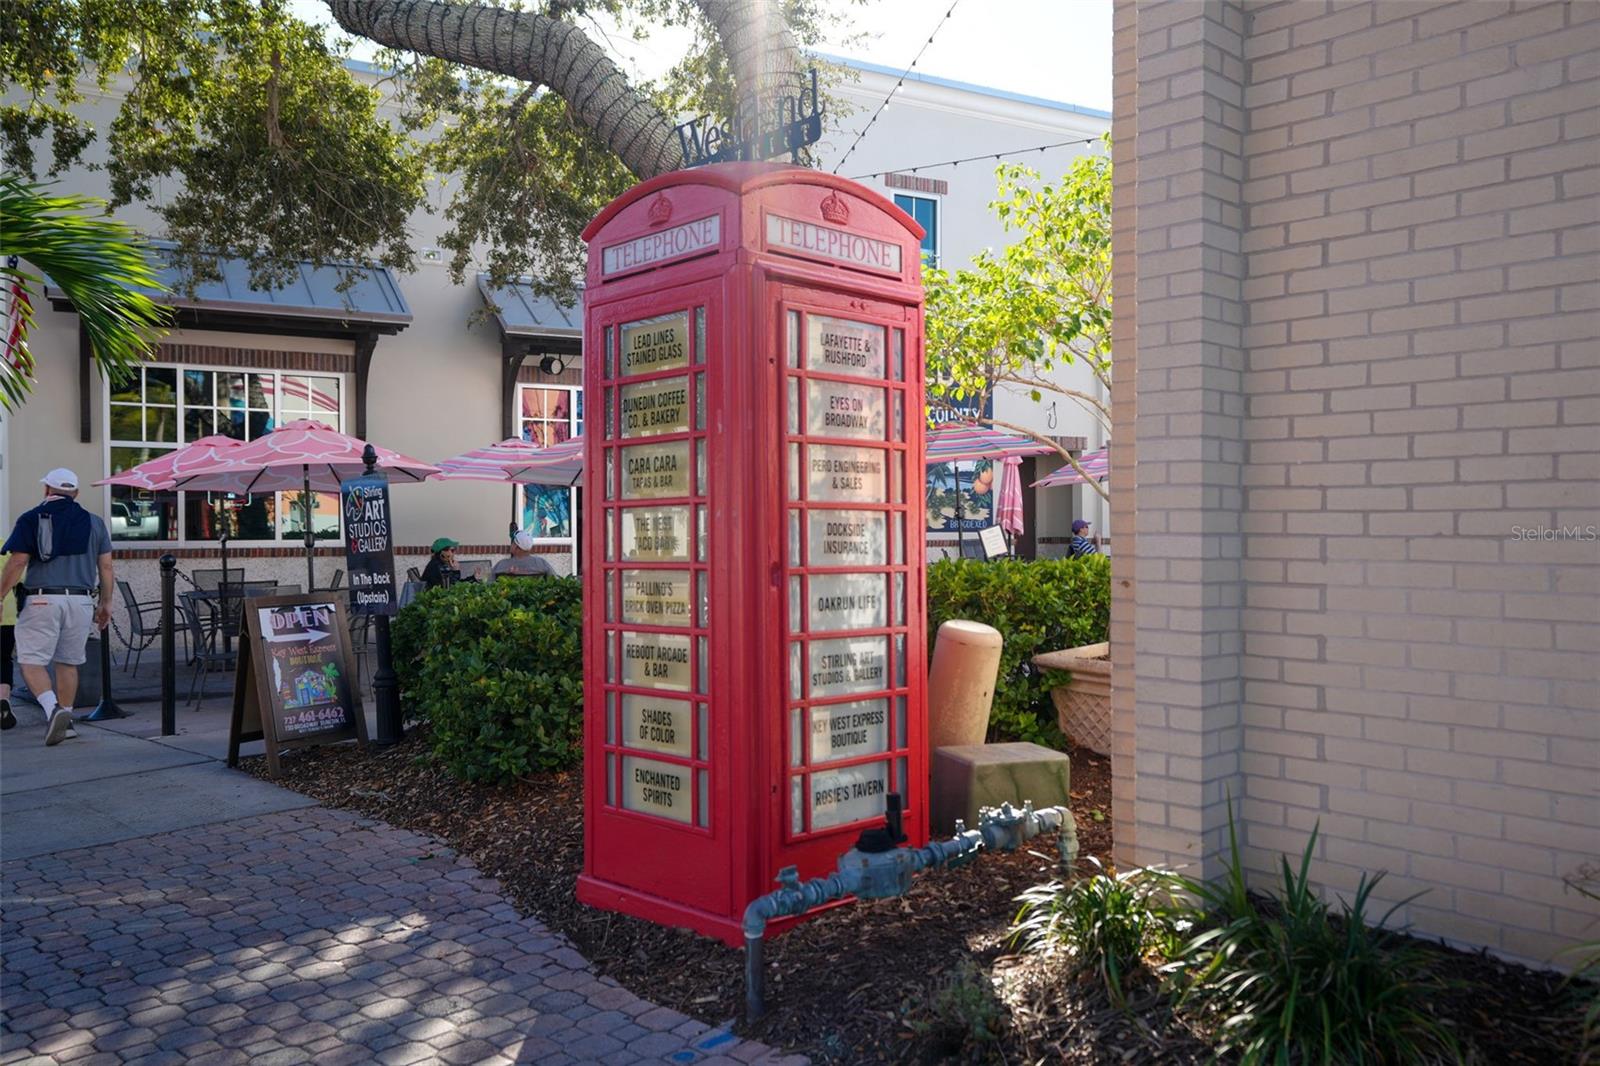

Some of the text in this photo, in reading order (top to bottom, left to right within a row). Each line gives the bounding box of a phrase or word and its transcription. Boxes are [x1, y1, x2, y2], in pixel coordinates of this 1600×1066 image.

[612, 219, 713, 270] TELEPHONE
[776, 217, 892, 268] TELEPHONE
[633, 328, 675, 350] LEAD LINES
[821, 332, 871, 353] LAFAYETTE &
[627, 343, 683, 367] STAINED GLASS
[825, 349, 867, 368] RUSHFORD
[623, 389, 686, 413] DUNEDIN COFFEE
[830, 395, 863, 412] EYES ON
[628, 408, 680, 429] CO. & BAKERY
[825, 412, 869, 429] BROADWAY
[628, 454, 677, 475] CARA CARA
[834, 460, 881, 474] ENGINEERING
[632, 476, 651, 489] TAPAS
[660, 475, 673, 487] BAR
[832, 477, 863, 490] & SALES
[365, 499, 385, 521] ART
[349, 520, 387, 538] STUDIOS
[636, 517, 651, 532] THE
[827, 522, 865, 537] DOCKSIDE
[358, 536, 388, 553] GALLERY
[823, 540, 869, 555] INSURANCE
[353, 572, 391, 585] In The Back
[646, 600, 663, 614] OVEN
[665, 601, 686, 615] PIZZA
[818, 595, 876, 612] OAKRUN LIFE
[272, 607, 330, 630] OPEN
[626, 643, 688, 664] REBOOT ARCADE
[821, 651, 875, 670] STIRLING ART
[644, 663, 668, 678] & BAR
[812, 670, 844, 686] STUDIOS
[854, 666, 883, 682] GALLERY
[642, 708, 672, 727] SHADES
[813, 710, 884, 734] KEY WEST EXPRESS
[639, 725, 675, 744] OF COLOR
[831, 730, 868, 748] BOUTIQUE
[635, 768, 681, 791] ENCHANTED
[642, 787, 673, 807] SPIRITS
[815, 778, 884, 806] ROSIE'S TAVERN
